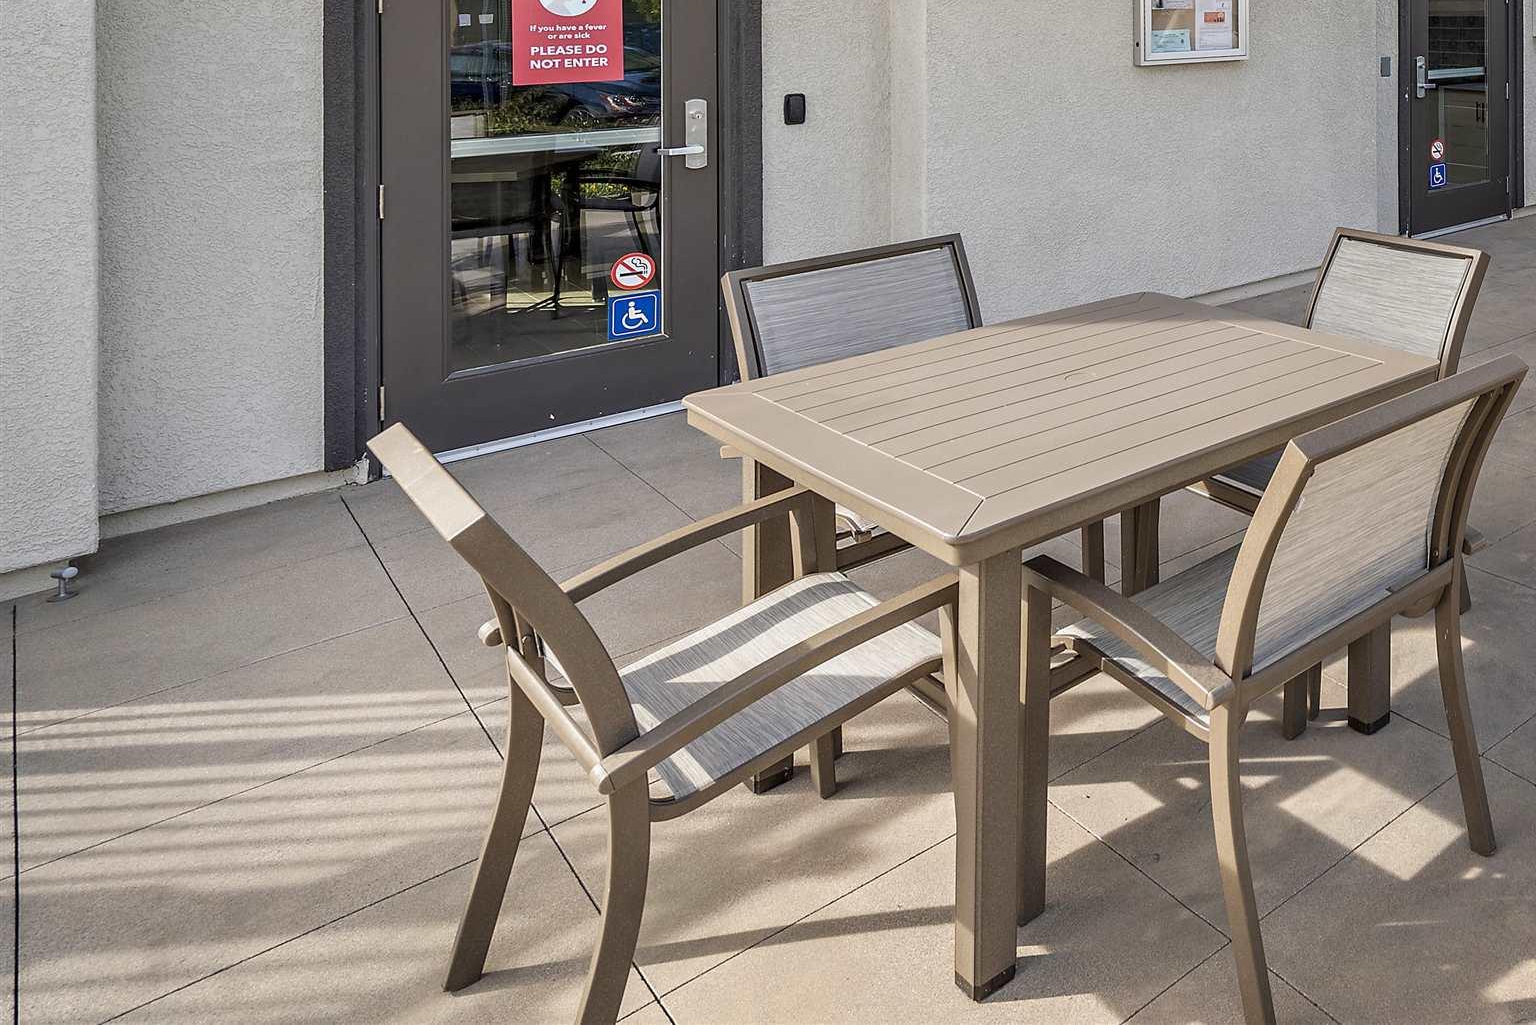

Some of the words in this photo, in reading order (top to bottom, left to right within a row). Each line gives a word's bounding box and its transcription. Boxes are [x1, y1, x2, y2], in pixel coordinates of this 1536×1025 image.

[530, 45, 582, 56] PLEASE
[585, 44, 608, 54] DO
[529, 58, 561, 69] NOT
[564, 57, 609, 68] ENTER
